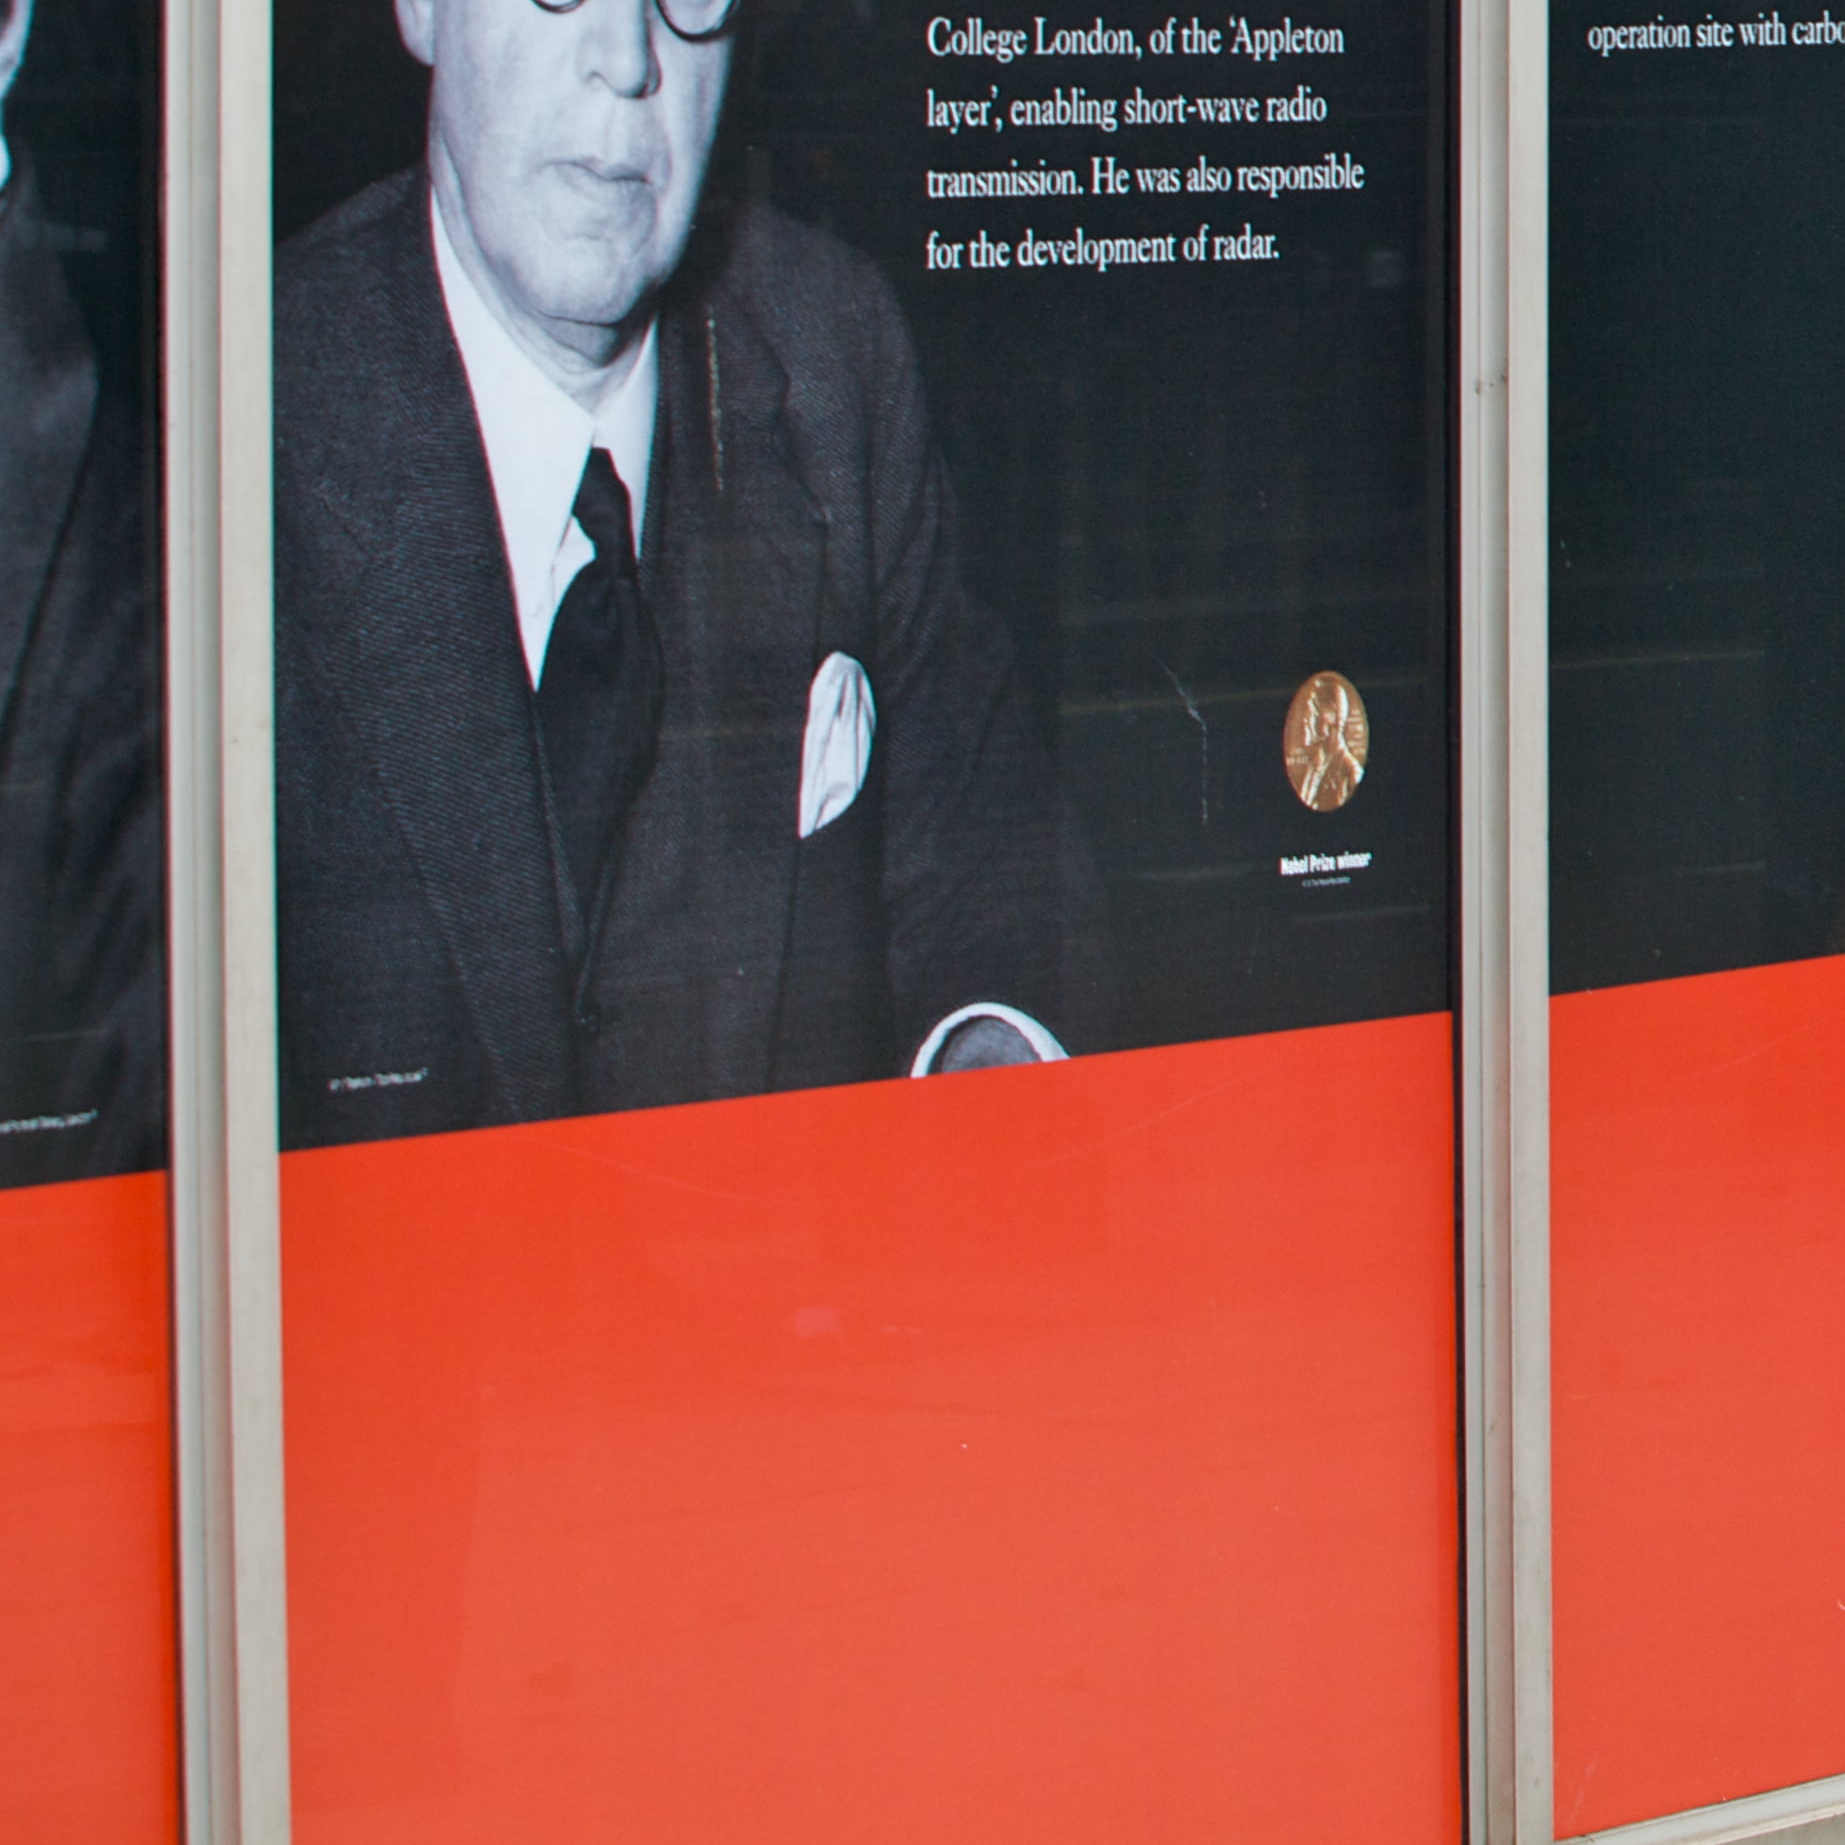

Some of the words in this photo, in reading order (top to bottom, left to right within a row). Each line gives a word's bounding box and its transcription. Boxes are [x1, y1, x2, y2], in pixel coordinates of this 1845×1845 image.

[928, 17, 1025, 63] College
[1035, 17, 1141, 59] London,
[1150, 17, 1175, 54] of
[1182, 17, 1220, 54] the
[1588, 15, 1690, 57] operation
[1696, 14, 1733, 47] site
[1739, 11, 1786, 45] with
[1011, 87, 1116, 132] enabling
[1124, 87, 1258, 124] short-wave
[1267, 85, 1326, 122] radio
[927, 159, 1082, 198] transmission.
[1092, 157, 1128, 194] He
[1136, 168, 1180, 192] was
[1187, 155, 1231, 192] also
[1237, 153, 1363, 198] responsible
[927, 231, 962, 269] for
[969, 230, 1009, 268] the
[1017, 227, 1174, 272] development
[1183, 224, 1208, 261] of
[1214, 223, 1278, 260] radar.
